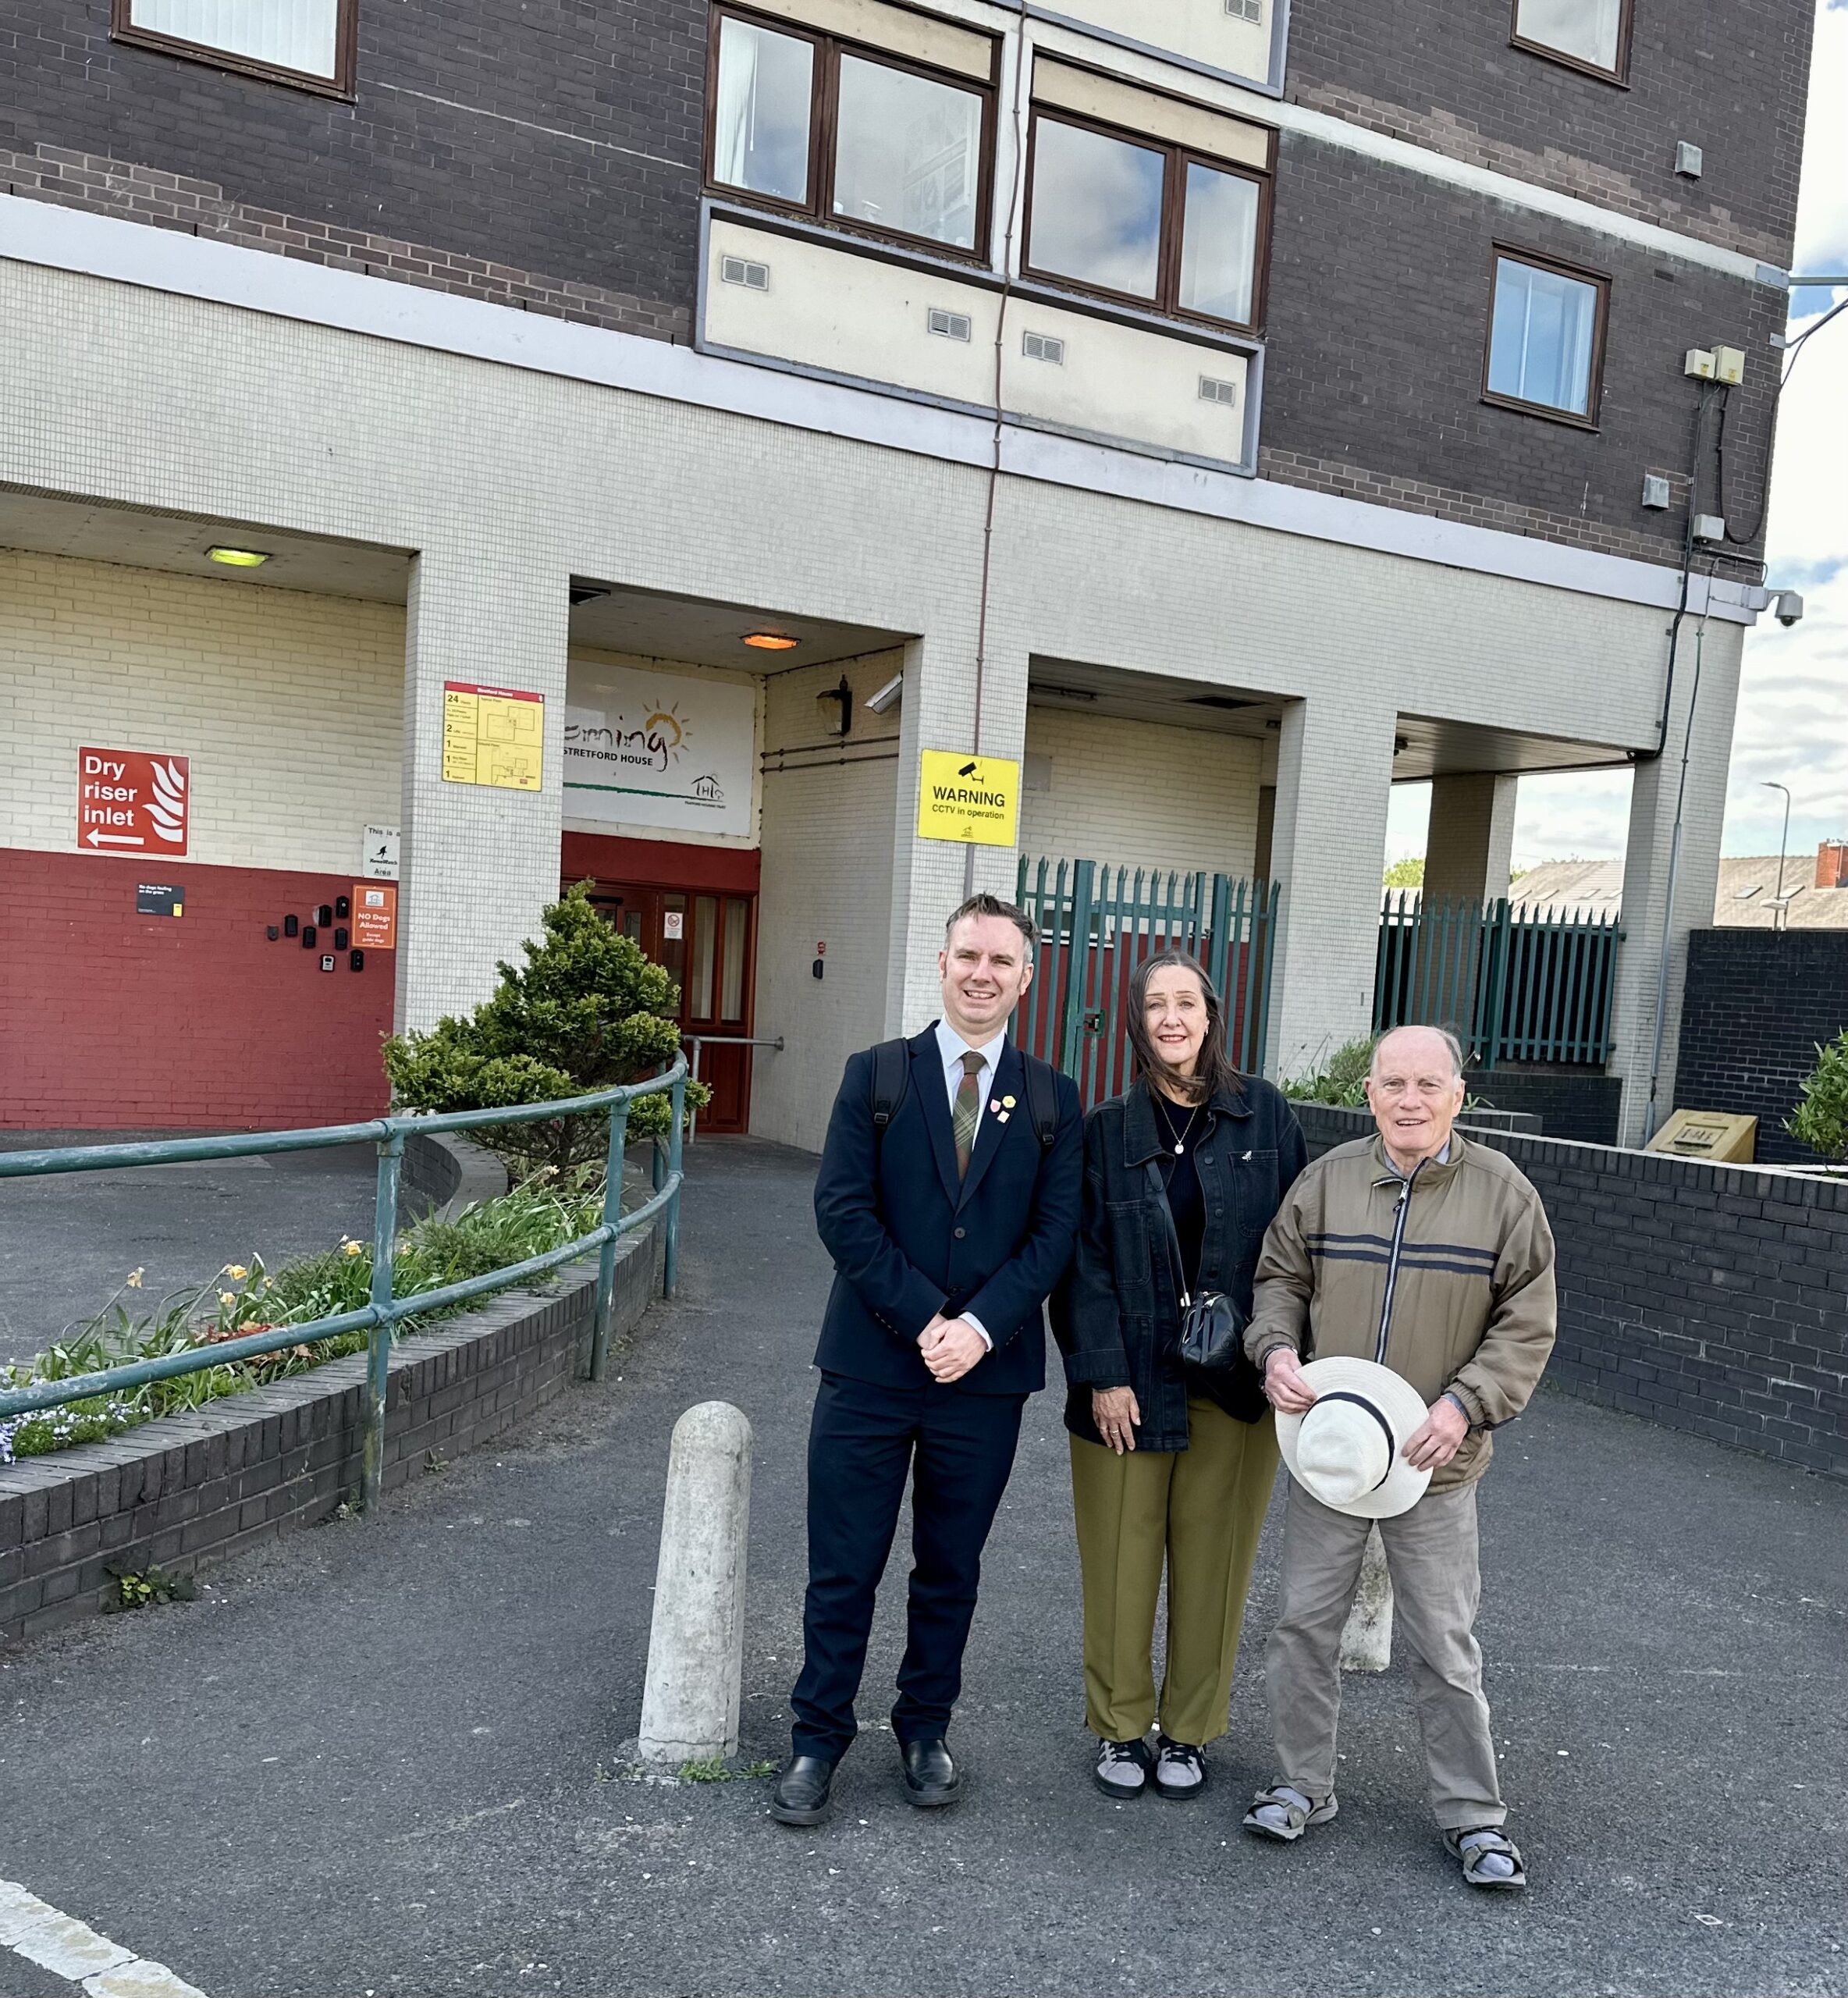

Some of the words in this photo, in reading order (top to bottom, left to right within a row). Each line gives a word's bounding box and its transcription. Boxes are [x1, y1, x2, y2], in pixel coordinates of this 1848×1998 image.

[447, 694, 459, 702] 24
[446, 723, 453, 732] 2
[621, 754, 653, 766] HOUSE
[85, 755, 126, 781] Dry
[84, 781, 138, 802] riser
[933, 786, 1005, 808] WARNING
[84, 805, 135, 827] inlet
[932, 804, 955, 814] CCTV
[967, 809, 1004, 819] operation
[372, 914, 390, 923] Dogs
